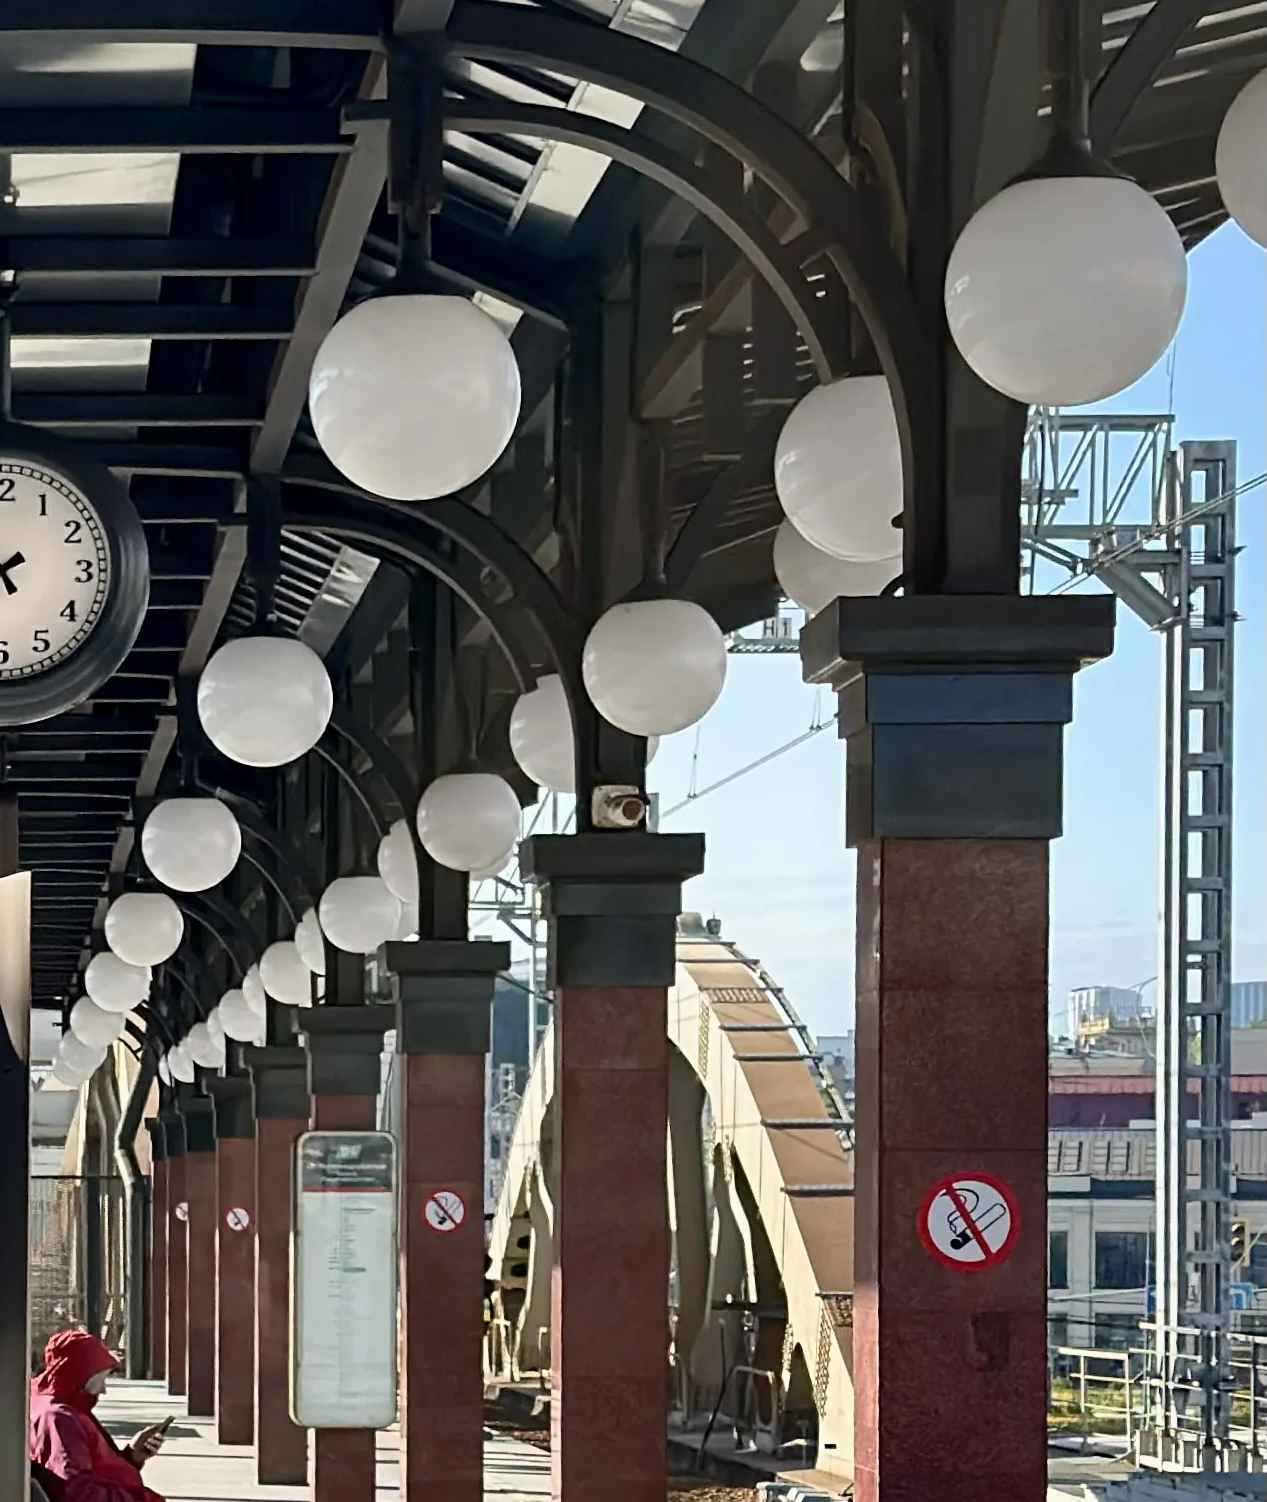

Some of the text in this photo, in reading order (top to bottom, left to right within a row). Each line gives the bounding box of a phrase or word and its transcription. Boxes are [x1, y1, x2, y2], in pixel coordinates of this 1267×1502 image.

[38, 494, 47, 516] 1
[64, 520, 81, 543] 2
[75, 560, 93, 583] 3
[60, 600, 78, 622] 4
[32, 629, 50, 652] 5
